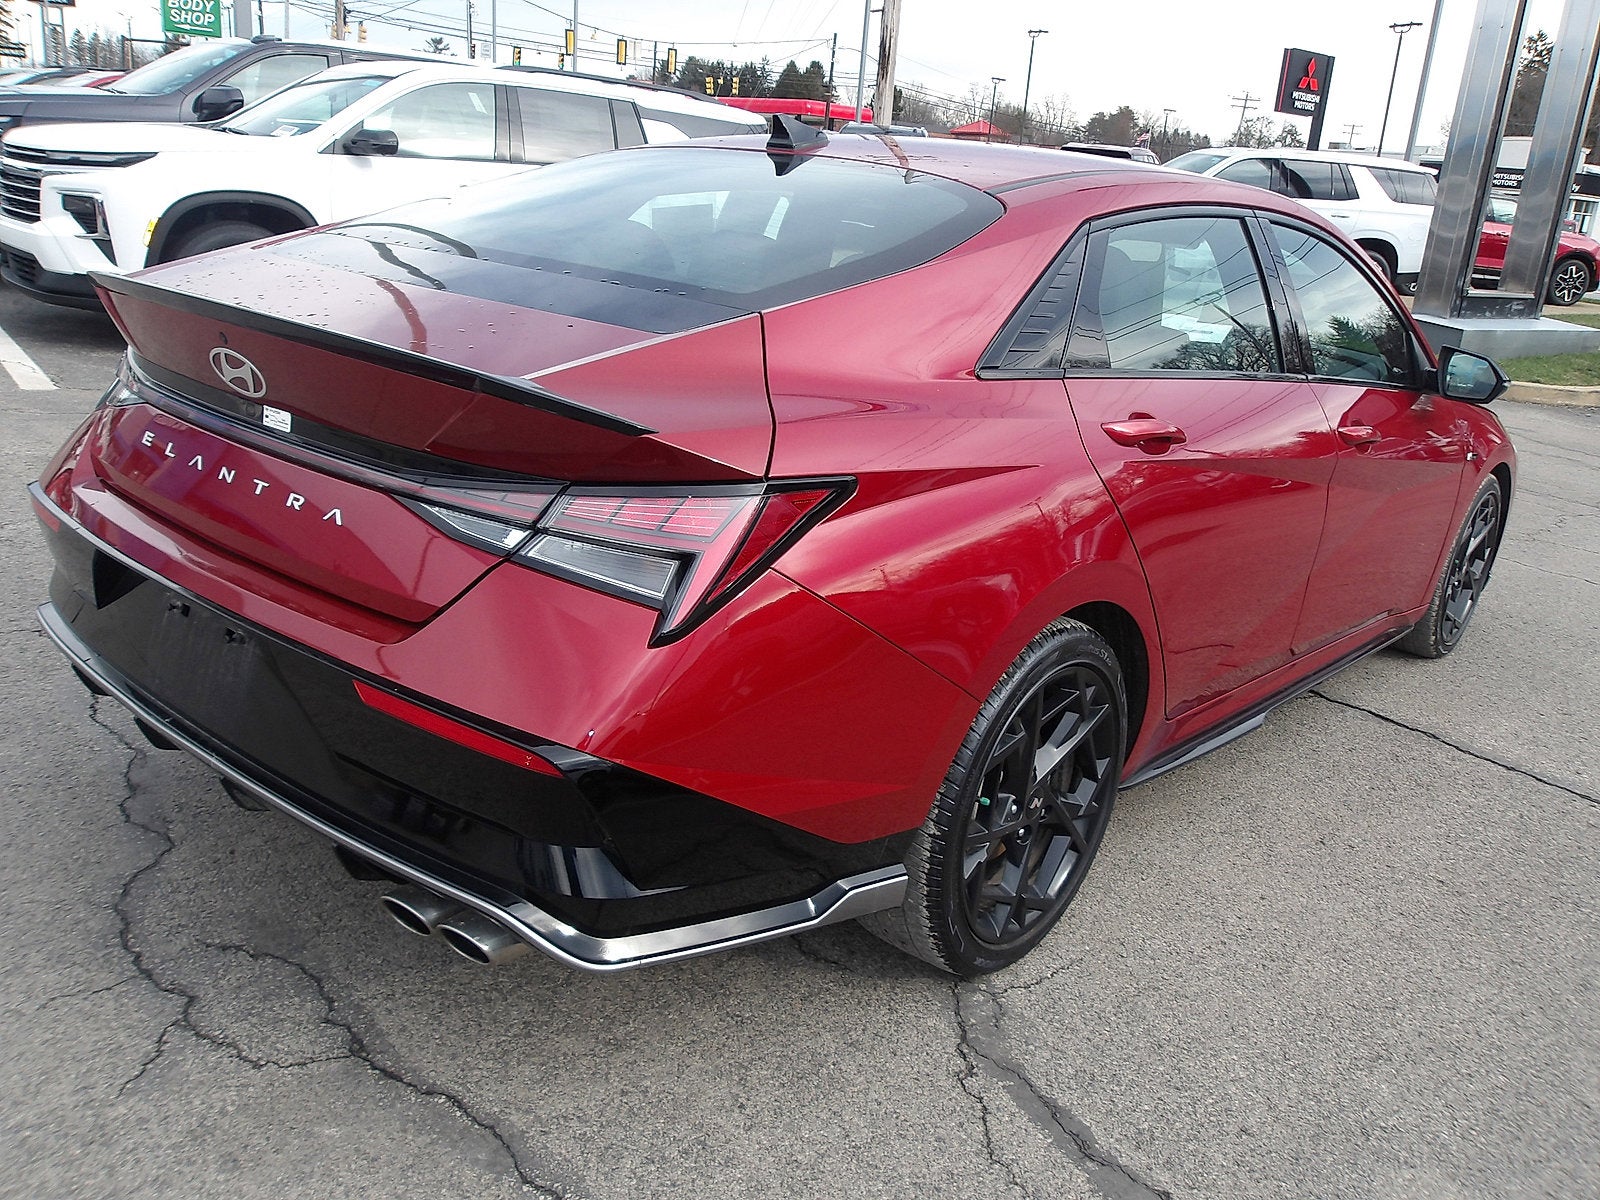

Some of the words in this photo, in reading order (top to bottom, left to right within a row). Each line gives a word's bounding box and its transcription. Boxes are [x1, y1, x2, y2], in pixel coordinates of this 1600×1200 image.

[167, 0, 215, 13] BODY
[169, 8, 216, 26] SHOP
[1291, 91, 1321, 104] MITSUBISHI
[1293, 100, 1316, 111] MOTORS
[141, 430, 343, 527] ELANTRA
